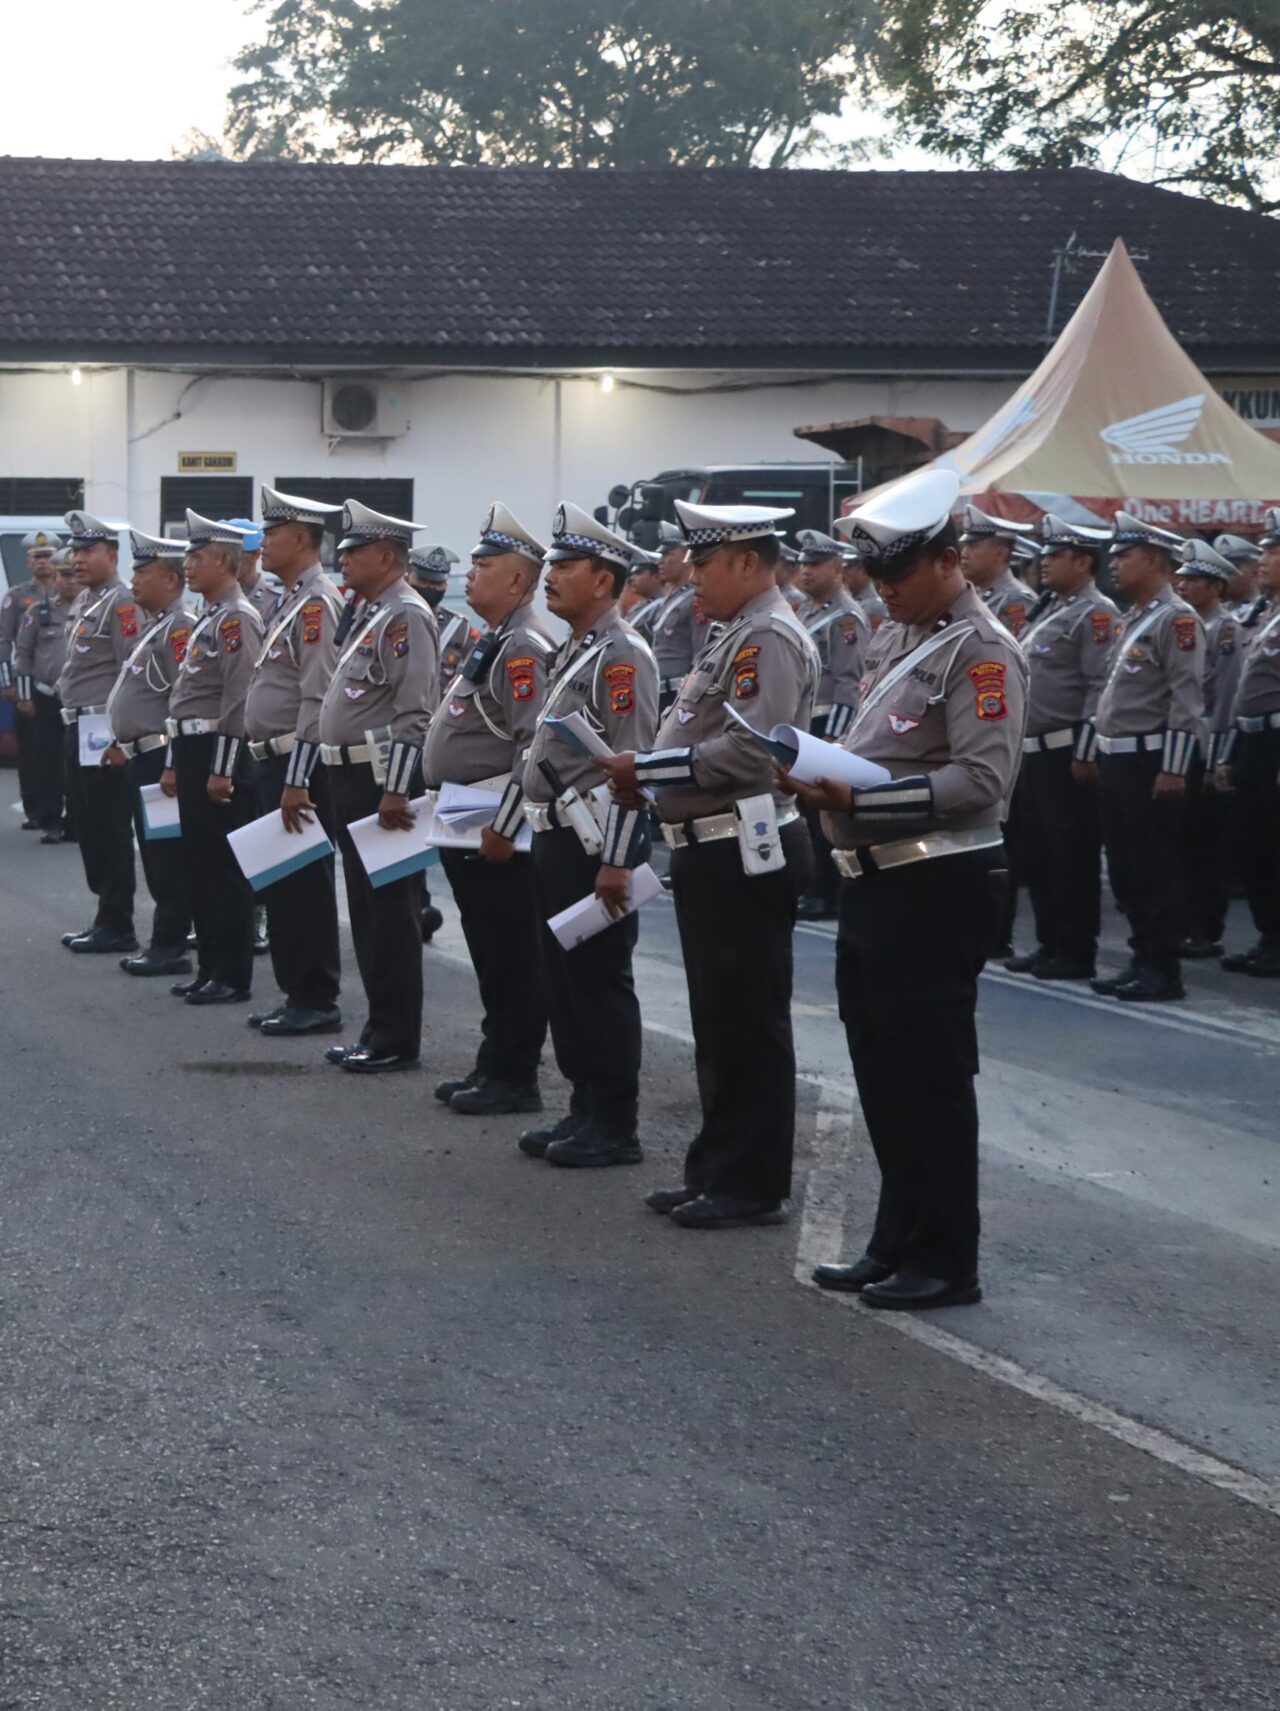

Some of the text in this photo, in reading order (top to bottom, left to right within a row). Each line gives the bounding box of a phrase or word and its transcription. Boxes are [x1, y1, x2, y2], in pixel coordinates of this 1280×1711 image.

[1111, 452, 1233, 465] HONDA
[1124, 498, 1173, 523] One
[909, 666, 937, 686] POLRI
